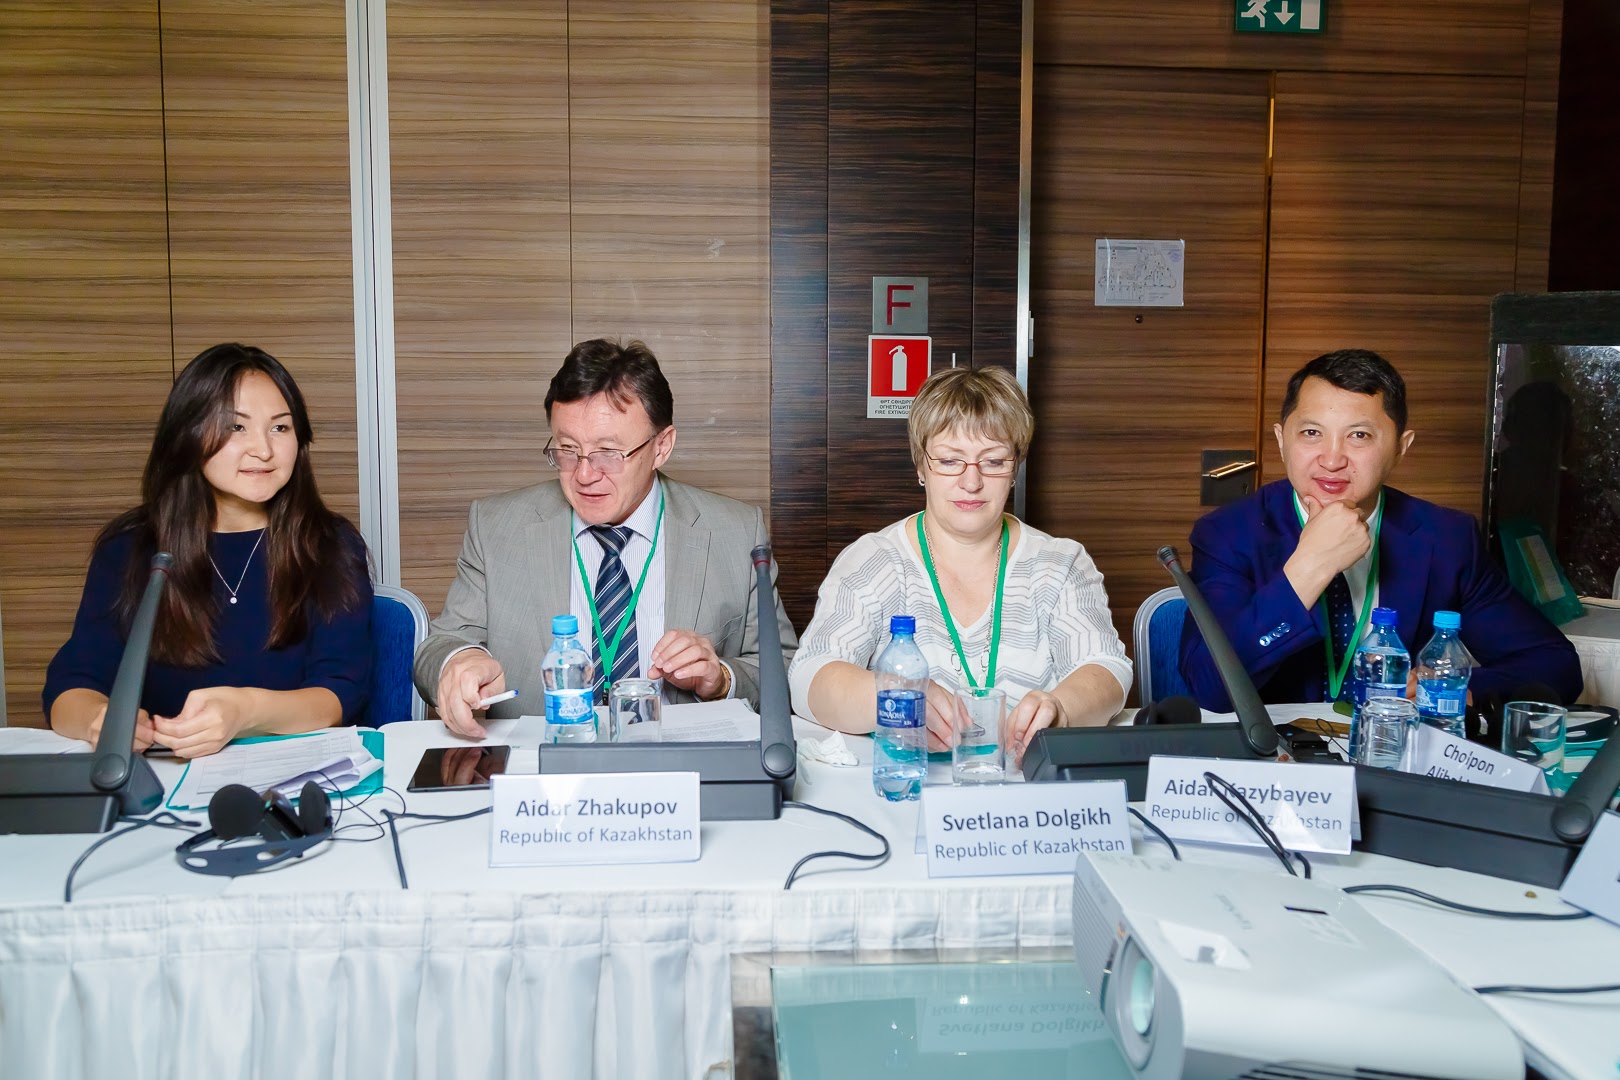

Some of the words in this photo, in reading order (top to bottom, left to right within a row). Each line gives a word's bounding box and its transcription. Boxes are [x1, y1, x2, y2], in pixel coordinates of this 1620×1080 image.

[887, 285, 914, 325] F
[515, 800, 572, 816] Aidar
[577, 798, 678, 819] Zhakupov
[942, 812, 1029, 832] Svetlana
[1036, 807, 1112, 830] Dolgikh
[1151, 804, 1221, 822] Republic
[499, 828, 573, 847] Republic
[577, 827, 595, 842] of
[600, 826, 693, 842] Kazakhstan
[935, 841, 1007, 861] Republic
[1012, 840, 1029, 855] of
[1033, 837, 1125, 855] Kazakhstan
